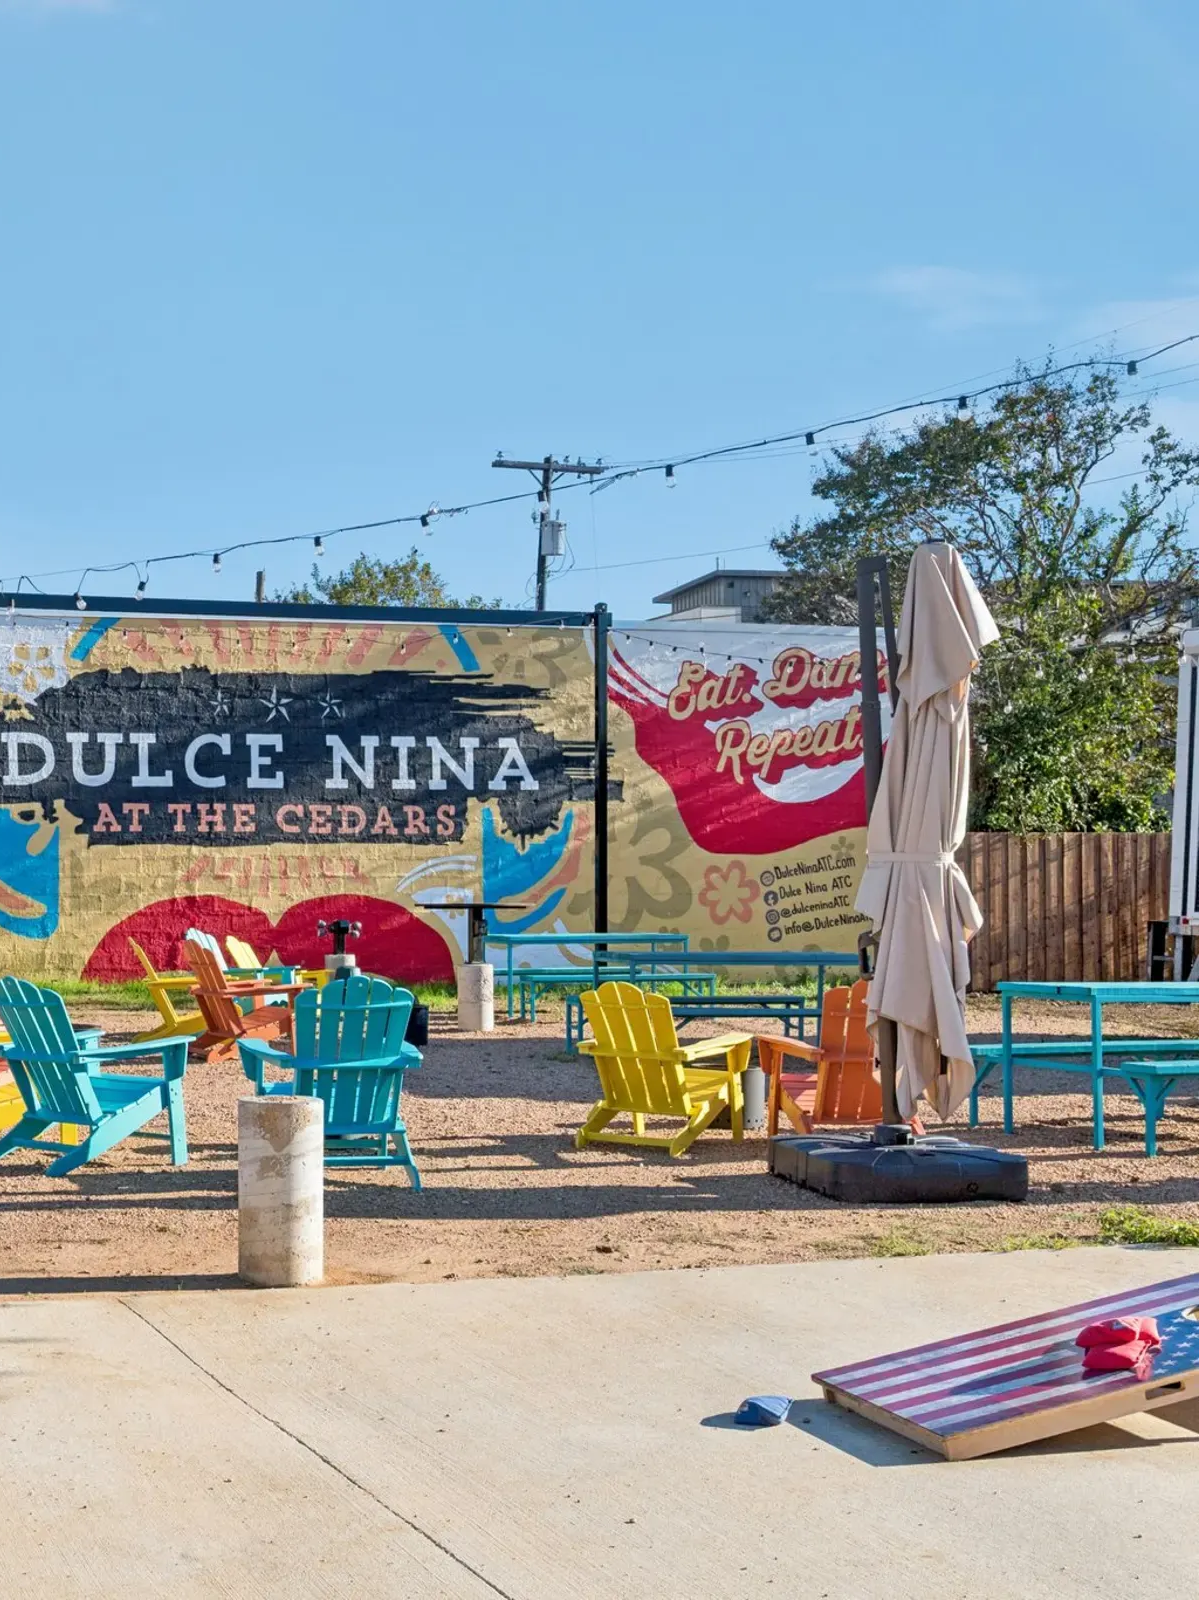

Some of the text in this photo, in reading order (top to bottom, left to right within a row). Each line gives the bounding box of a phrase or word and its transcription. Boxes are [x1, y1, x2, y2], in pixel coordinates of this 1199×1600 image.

[763, 647, 889, 697] Dan
[2, 731, 540, 791] DULCE NINA
[93, 803, 458, 836] AT THE CEDARS
[774, 854, 856, 880] DulceNinaATC.com
[779, 875, 853, 899] Dulce Nina ATC
[781, 896, 850, 918] @dulceninaATC
[785, 913, 873, 935] info@DulceNinaA
